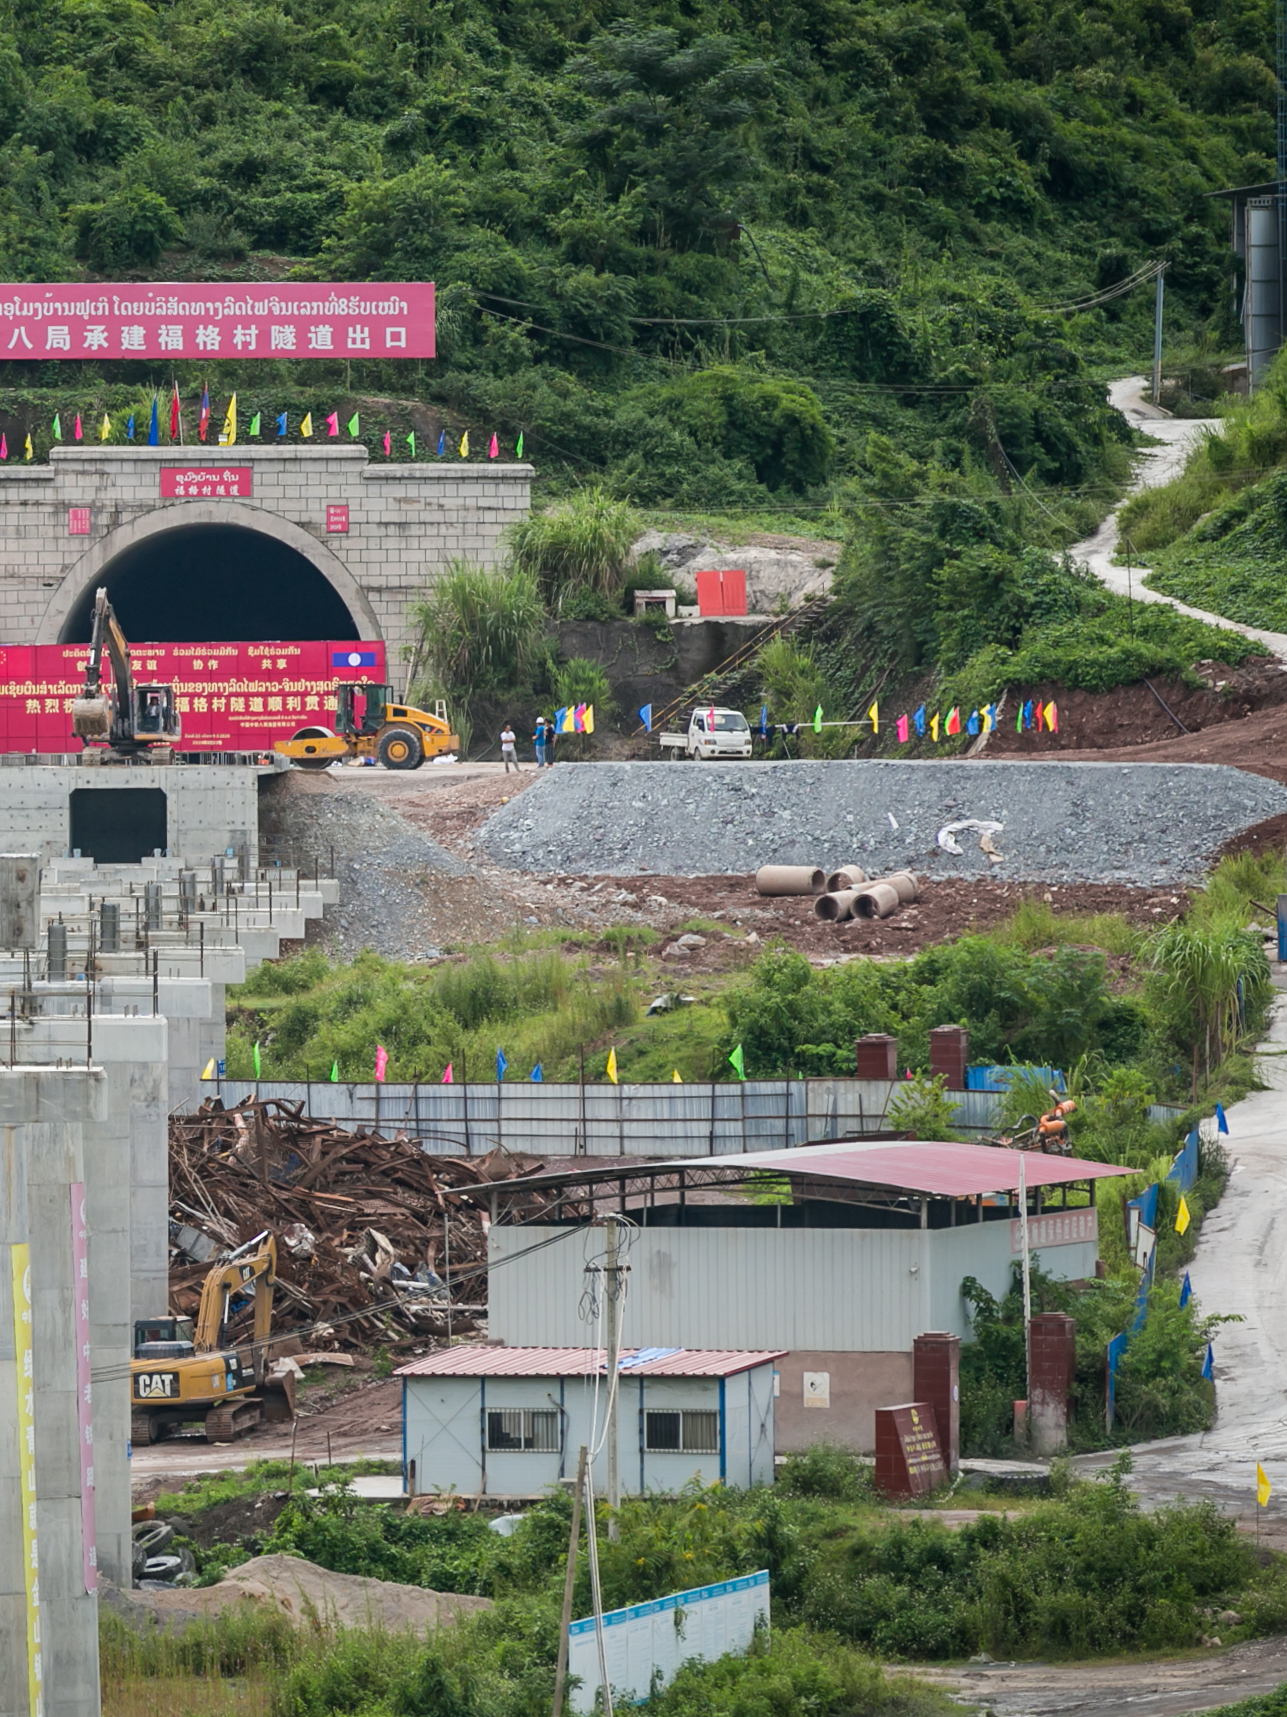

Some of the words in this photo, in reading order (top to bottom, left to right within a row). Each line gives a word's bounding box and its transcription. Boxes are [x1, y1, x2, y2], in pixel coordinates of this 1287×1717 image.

[174, 484, 240, 496] 福格村隧道
[132, 660, 157, 671] 友谊
[193, 659, 218, 670] 协作
[261, 658, 287, 670] 共享
[139, 1374, 173, 1397] CAT
